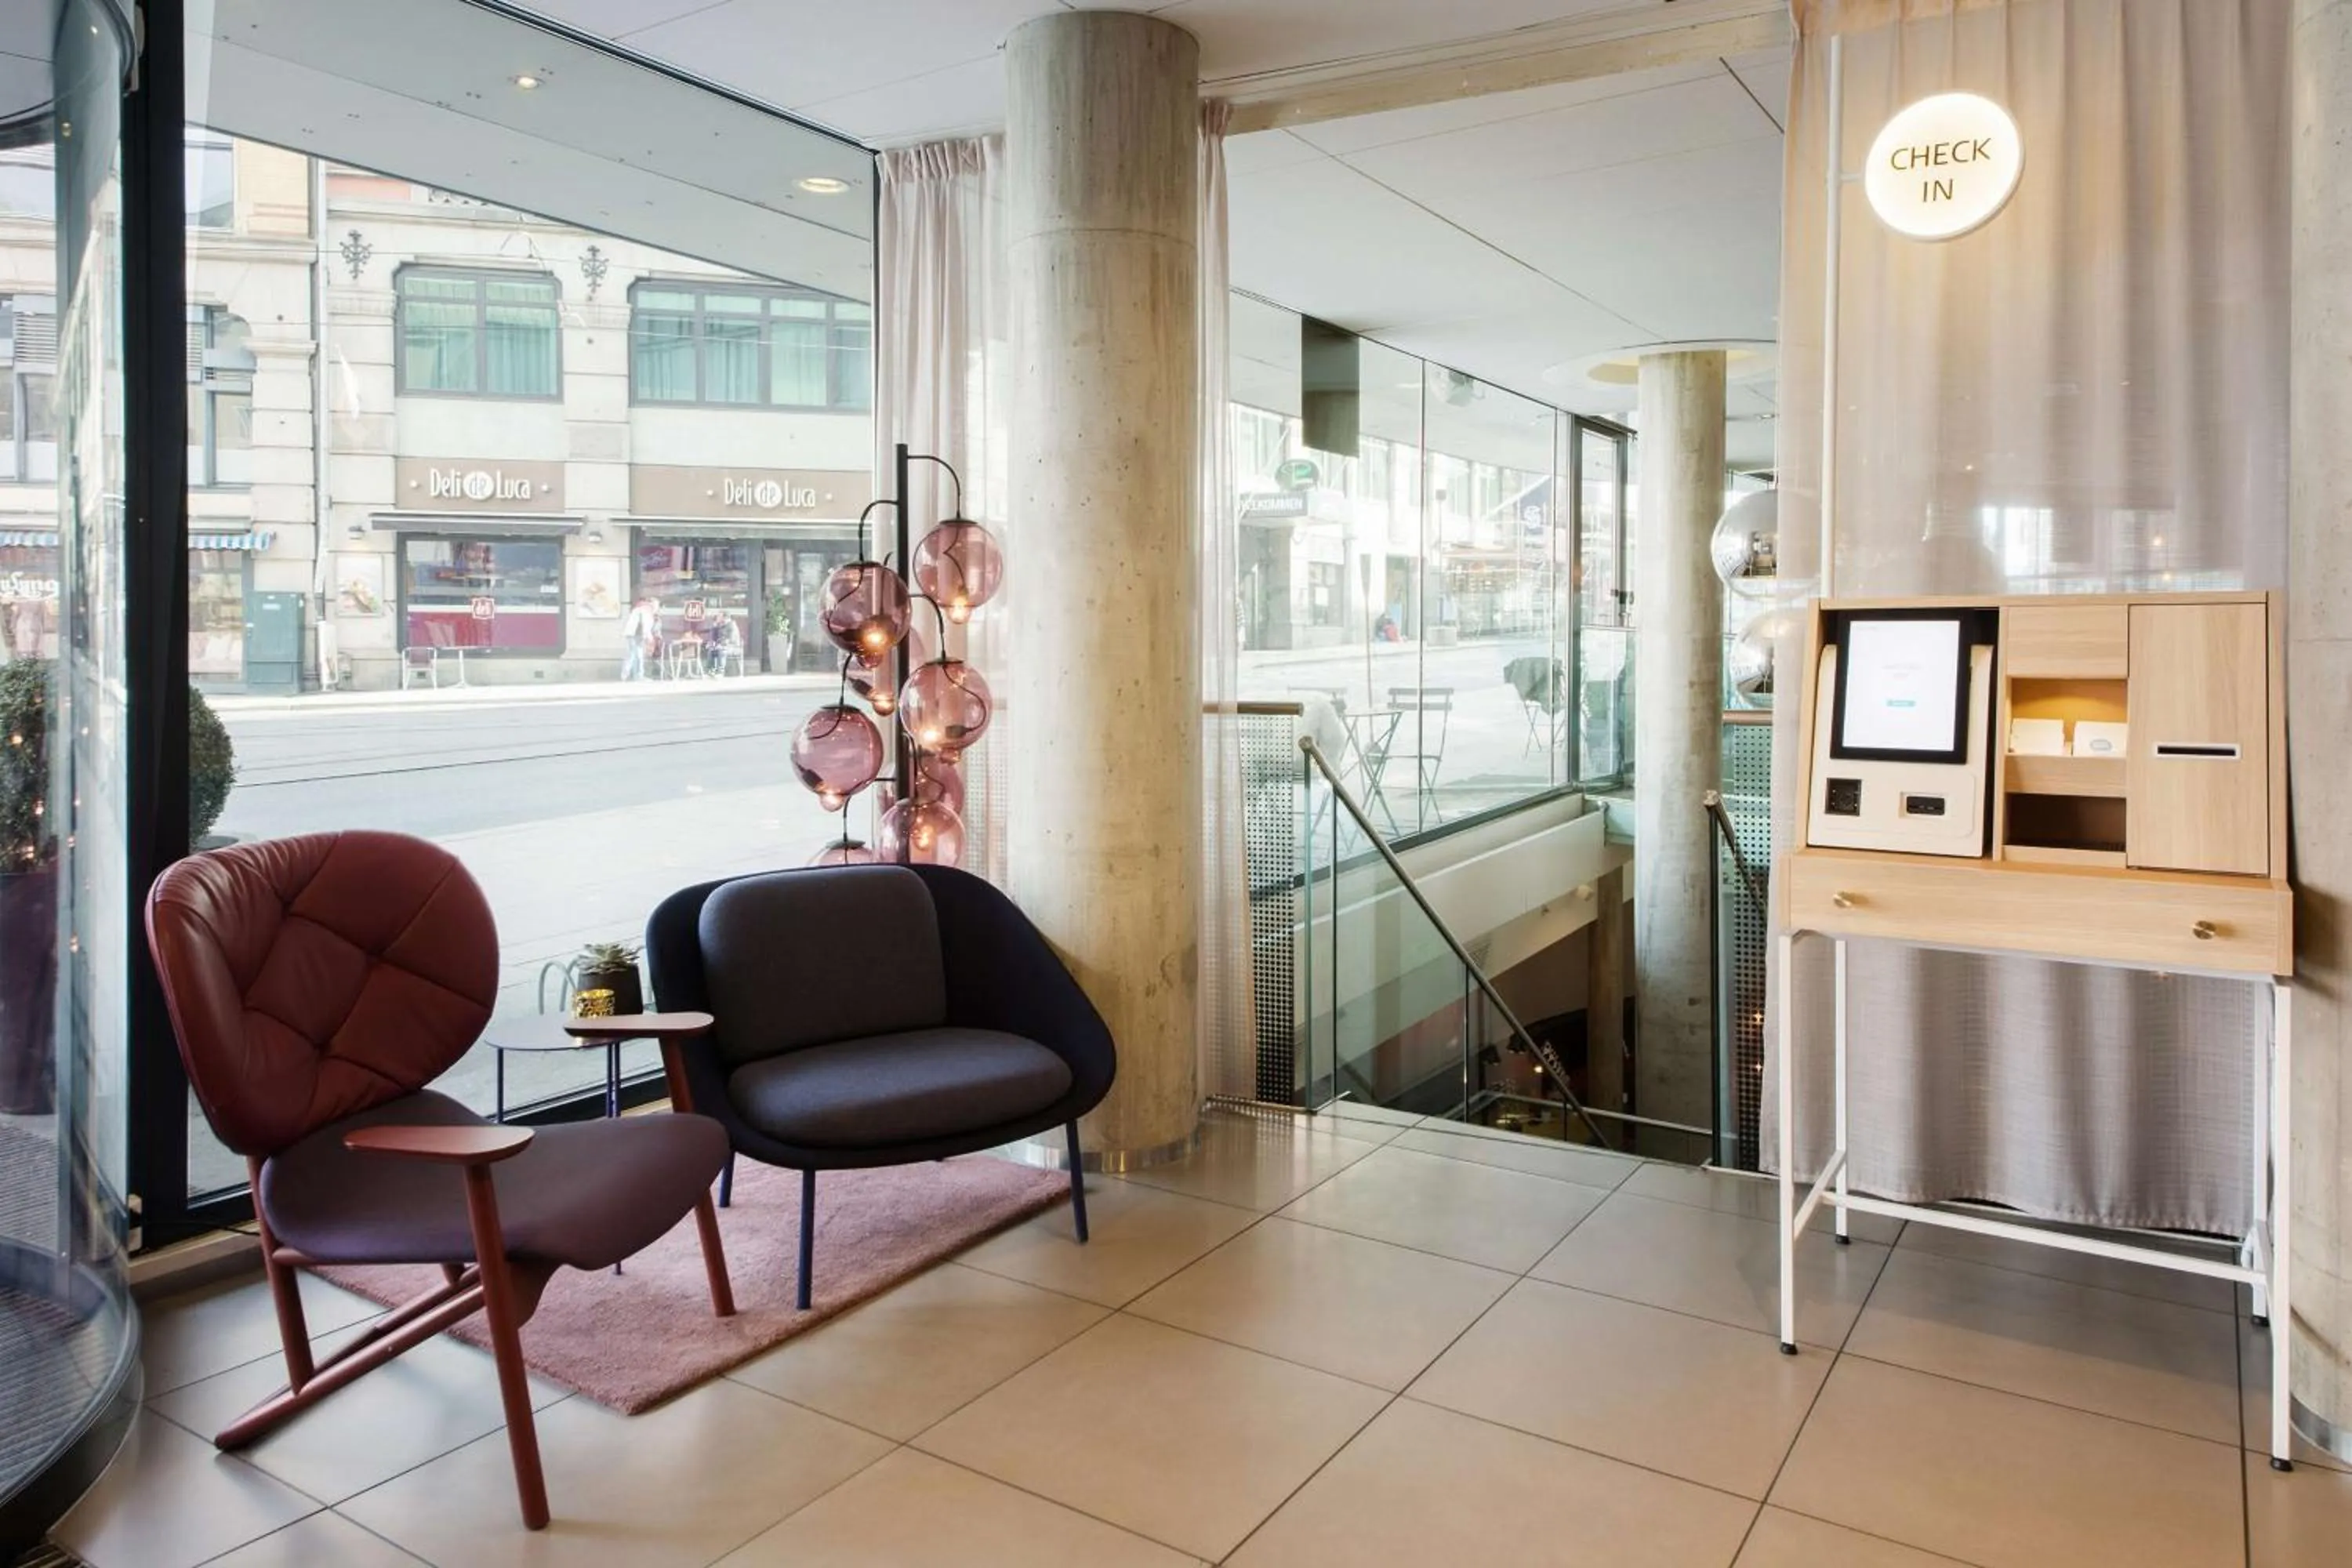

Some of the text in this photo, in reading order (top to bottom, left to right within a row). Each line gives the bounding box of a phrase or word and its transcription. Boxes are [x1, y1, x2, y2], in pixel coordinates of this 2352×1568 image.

[1891, 137, 1992, 170] CHECK
[1922, 177, 1955, 203] IN
[430, 468, 461, 498] Deli
[495, 469, 532, 499] Luca
[724, 477, 753, 506] Deli
[784, 479, 816, 507] Luca
